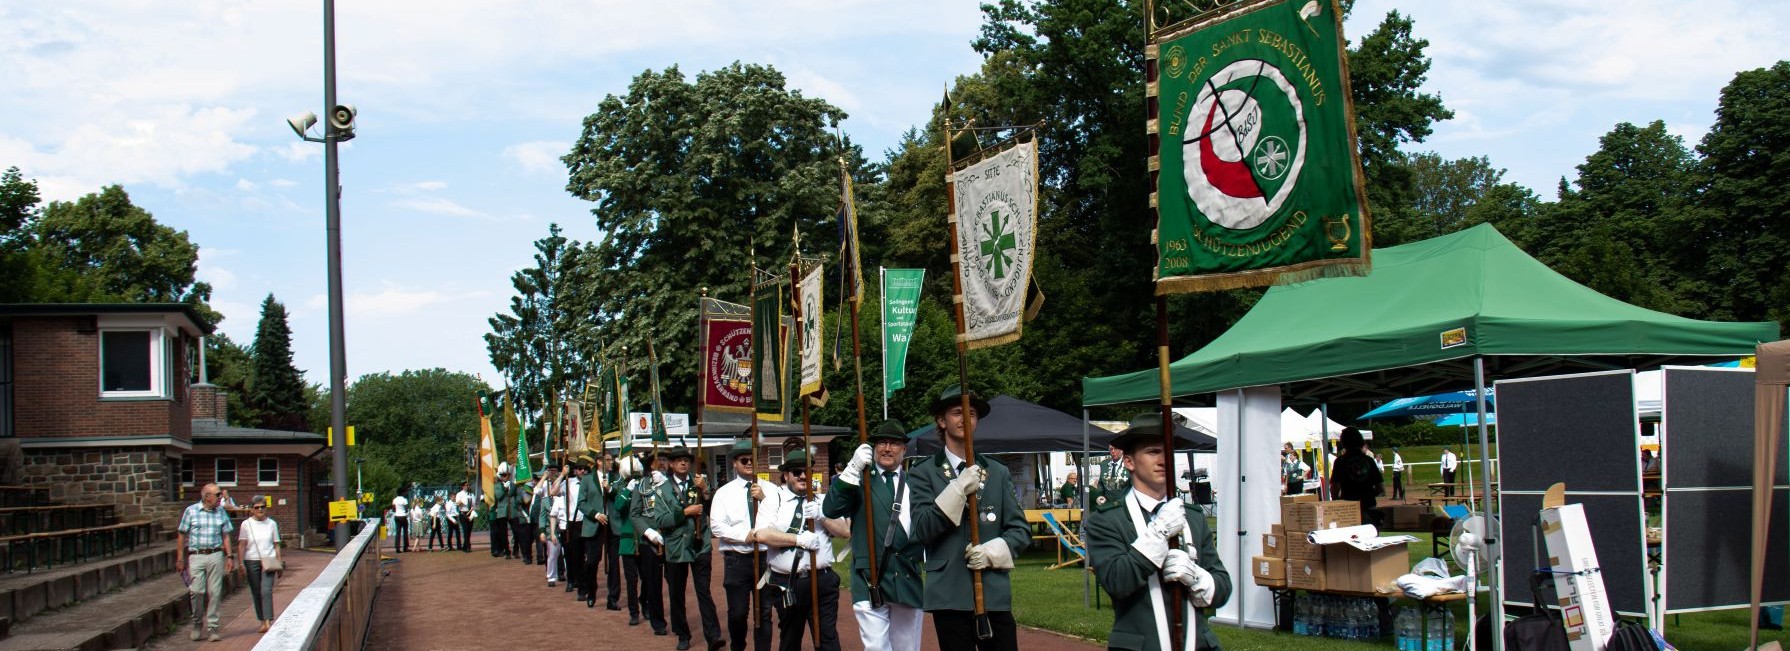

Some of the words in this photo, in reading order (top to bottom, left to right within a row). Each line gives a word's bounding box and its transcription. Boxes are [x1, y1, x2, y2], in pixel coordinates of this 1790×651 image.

[1168, 91, 1188, 136] BUND
[1187, 57, 1209, 84] DER
[1212, 28, 1252, 58] SANKT
[1257, 28, 1327, 107] SEBASTIANUS
[984, 165, 1001, 181] SITTE
[1164, 239, 1188, 252] 1963
[1164, 256, 1189, 269] 2008
